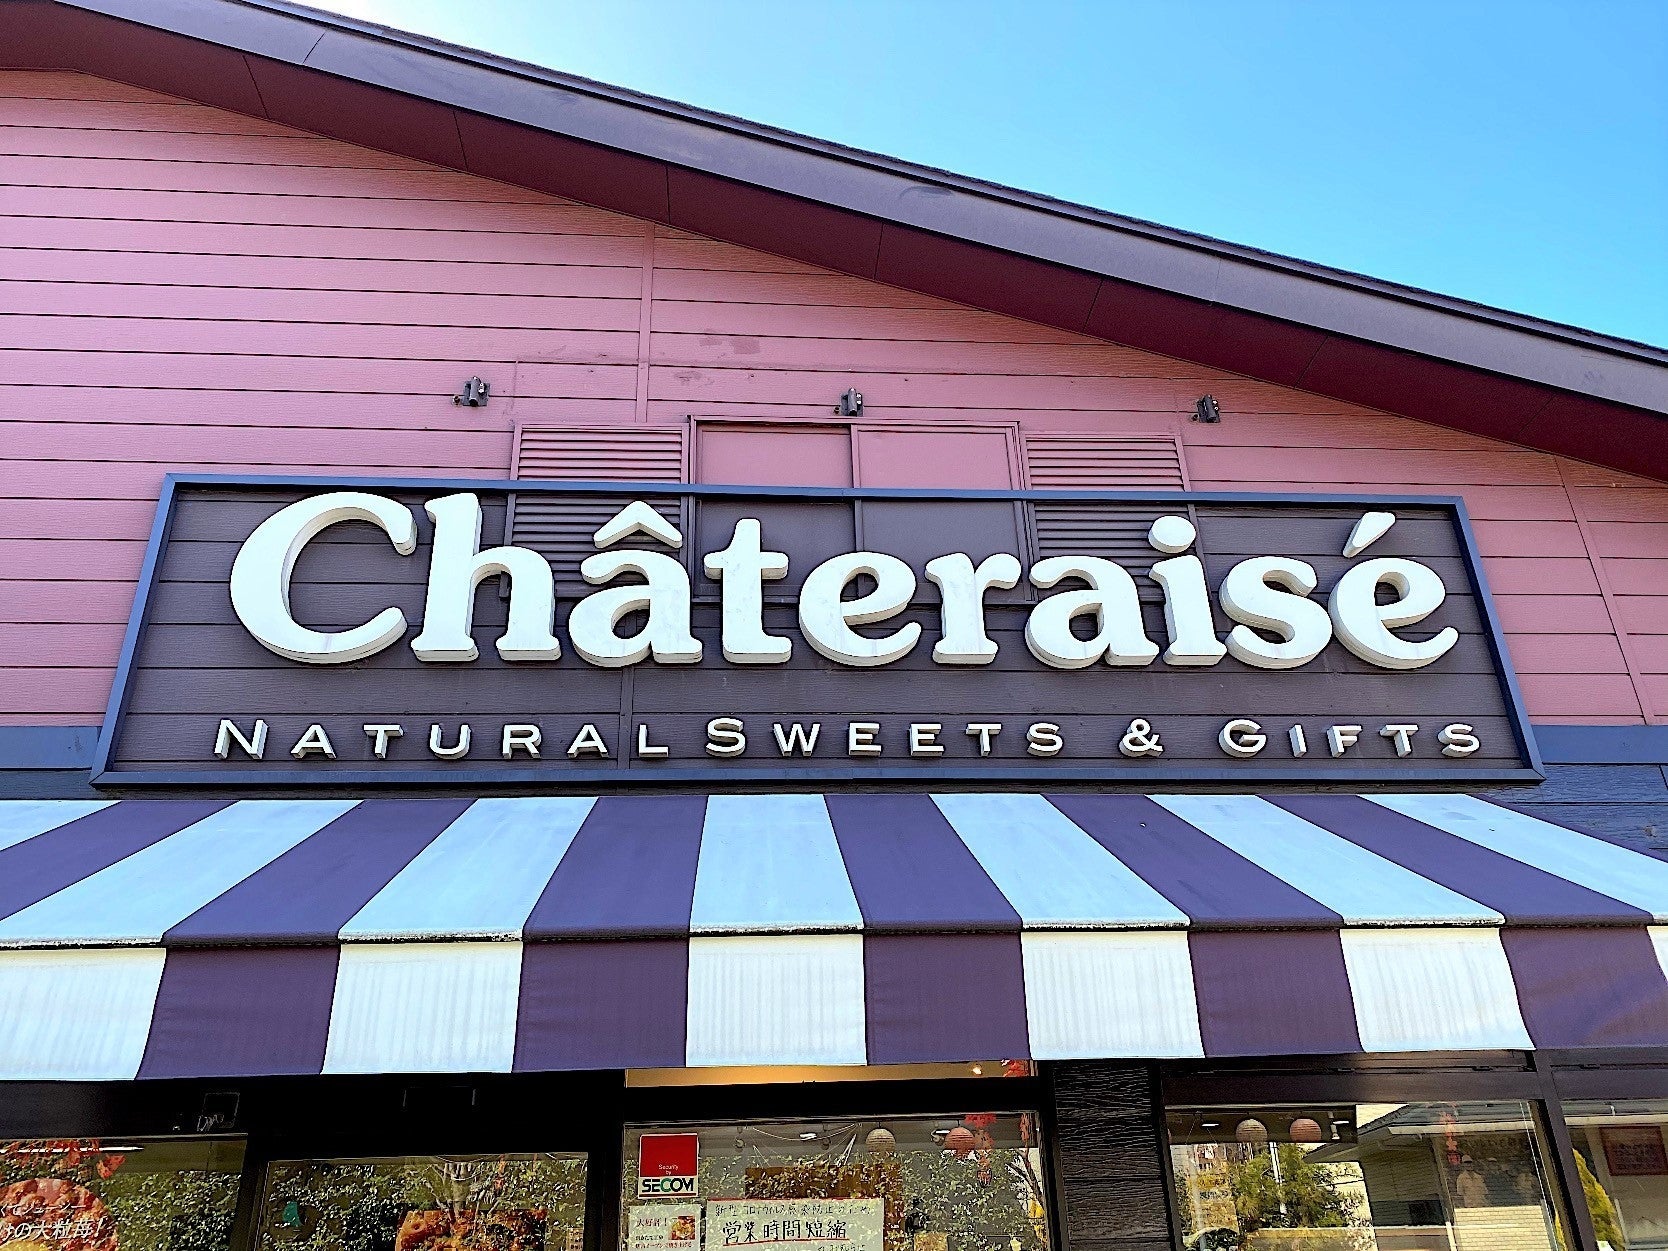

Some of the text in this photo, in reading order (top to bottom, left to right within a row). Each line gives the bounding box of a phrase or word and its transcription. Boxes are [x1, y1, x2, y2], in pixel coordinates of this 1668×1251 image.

[229, 491, 1459, 670] Châteraisé
[213, 717, 1481, 760] NATURAL SWEETS & GIFTS
[642, 1178, 694, 1192] SECOM
[722, 1219, 847, 1244] 営業時間短縮
